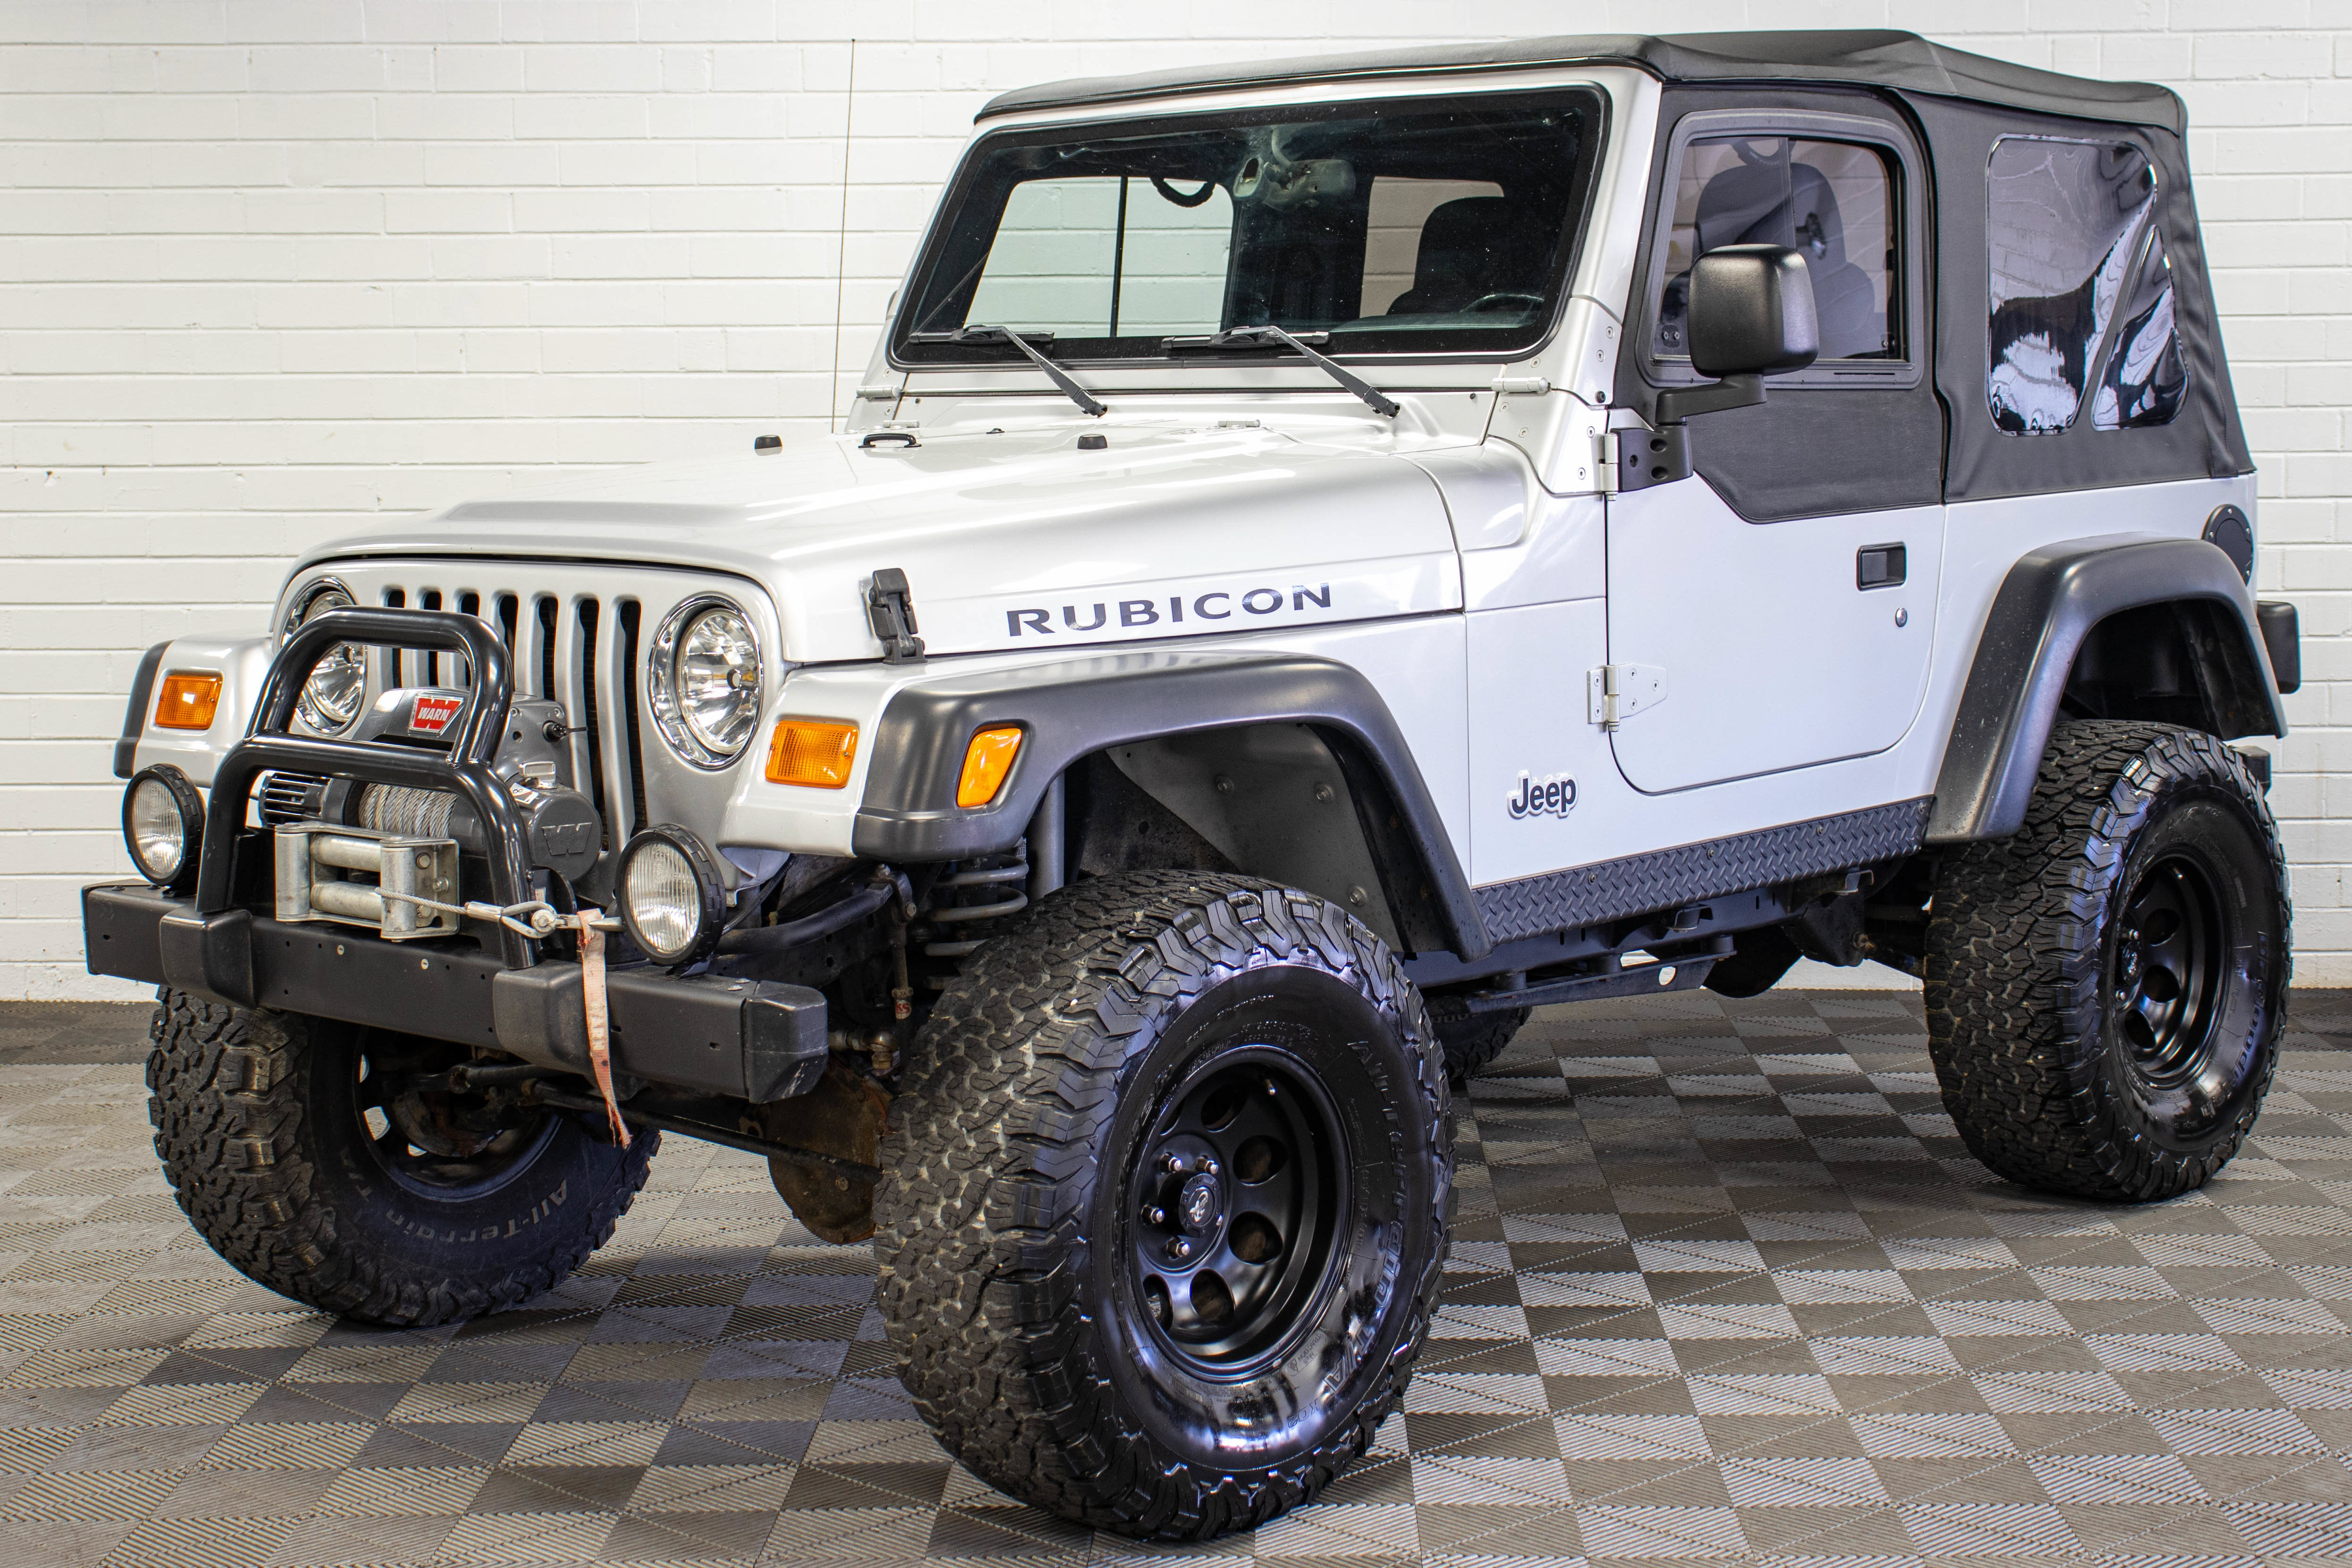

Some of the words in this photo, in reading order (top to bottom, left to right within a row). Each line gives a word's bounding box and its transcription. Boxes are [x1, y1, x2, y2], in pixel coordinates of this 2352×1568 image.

[1006, 582, 1331, 637] RUBICON
[417, 706, 451, 721] WARN
[1511, 778, 1576, 814] Jeep
[386, 1179, 567, 1242] All-Terrain
[1287, 1398, 1322, 1428] KO2
